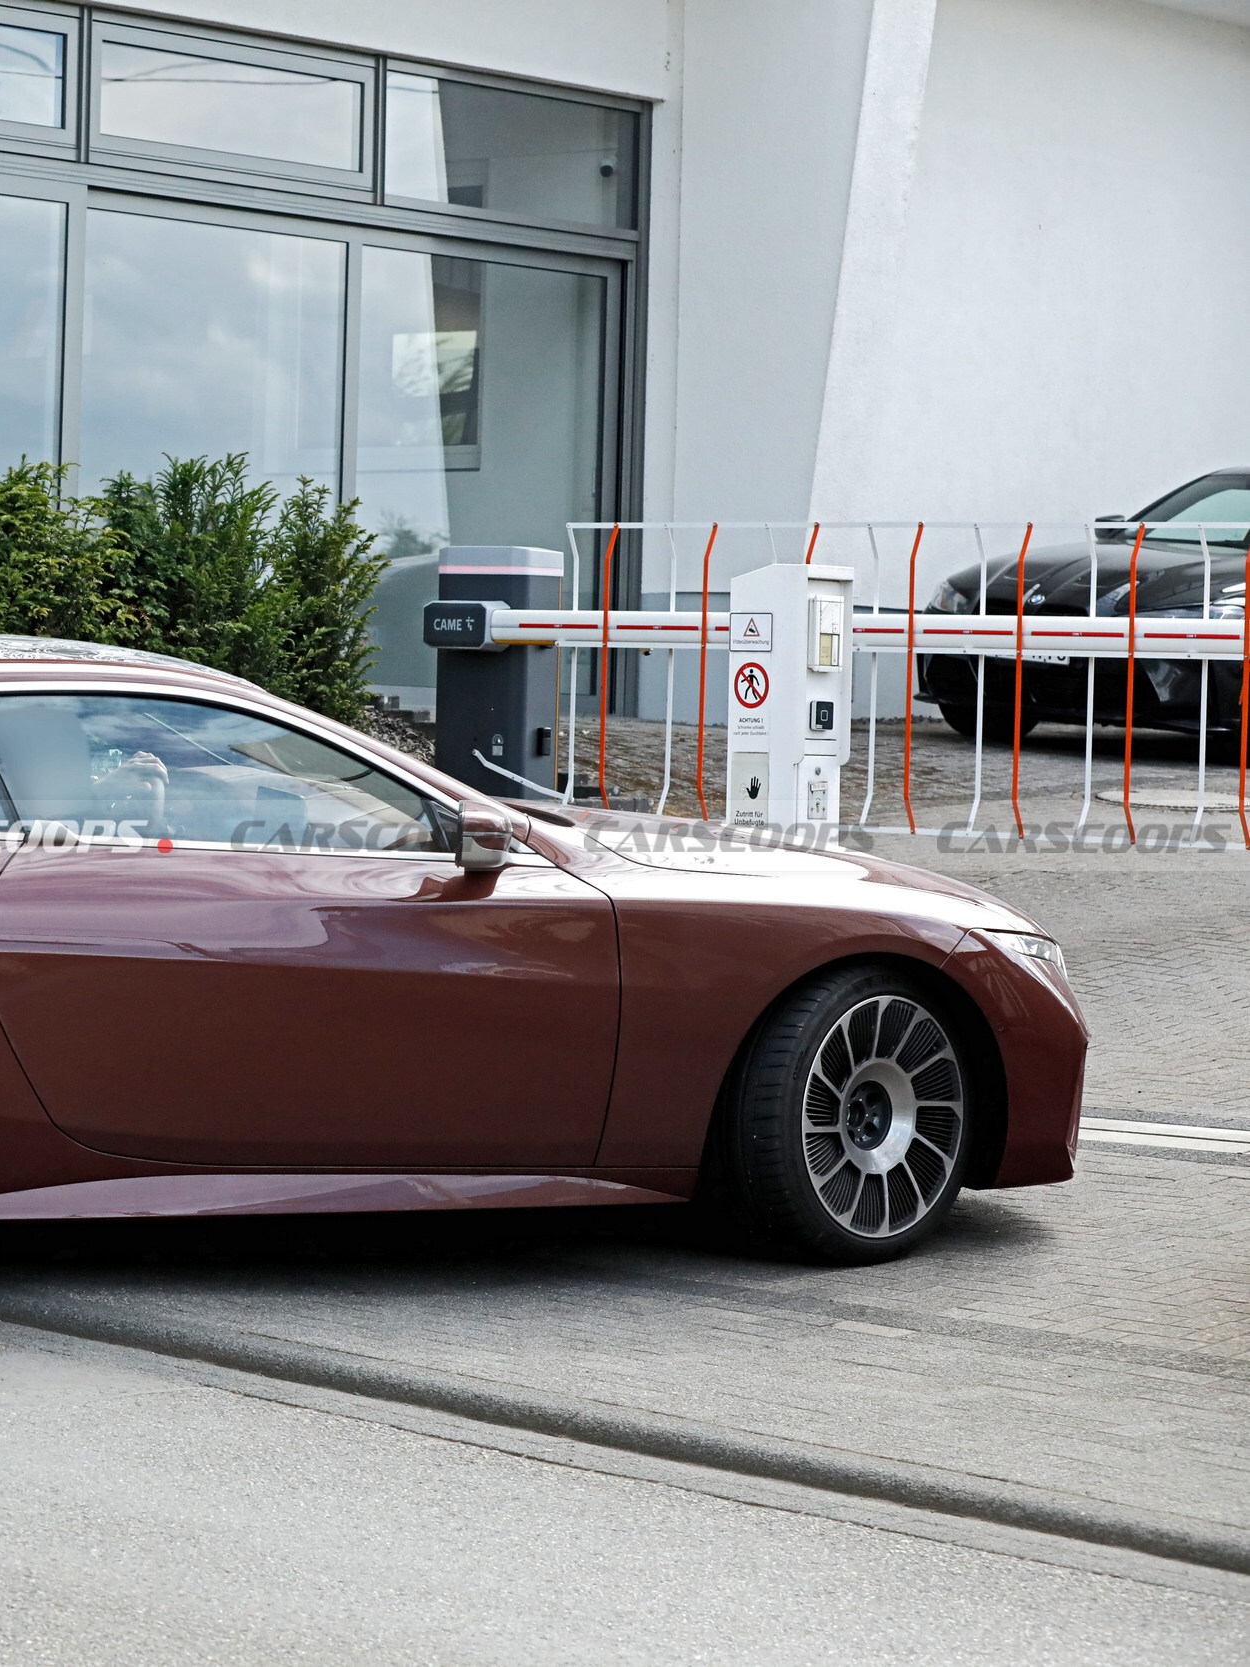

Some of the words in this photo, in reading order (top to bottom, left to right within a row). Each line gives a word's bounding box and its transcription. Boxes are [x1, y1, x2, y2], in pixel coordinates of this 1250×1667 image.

[433, 618, 462, 631] CAME
[735, 810, 753, 818] Zutritt
[754, 810, 763, 818] für
[734, 818, 765, 827] Unbefugte
